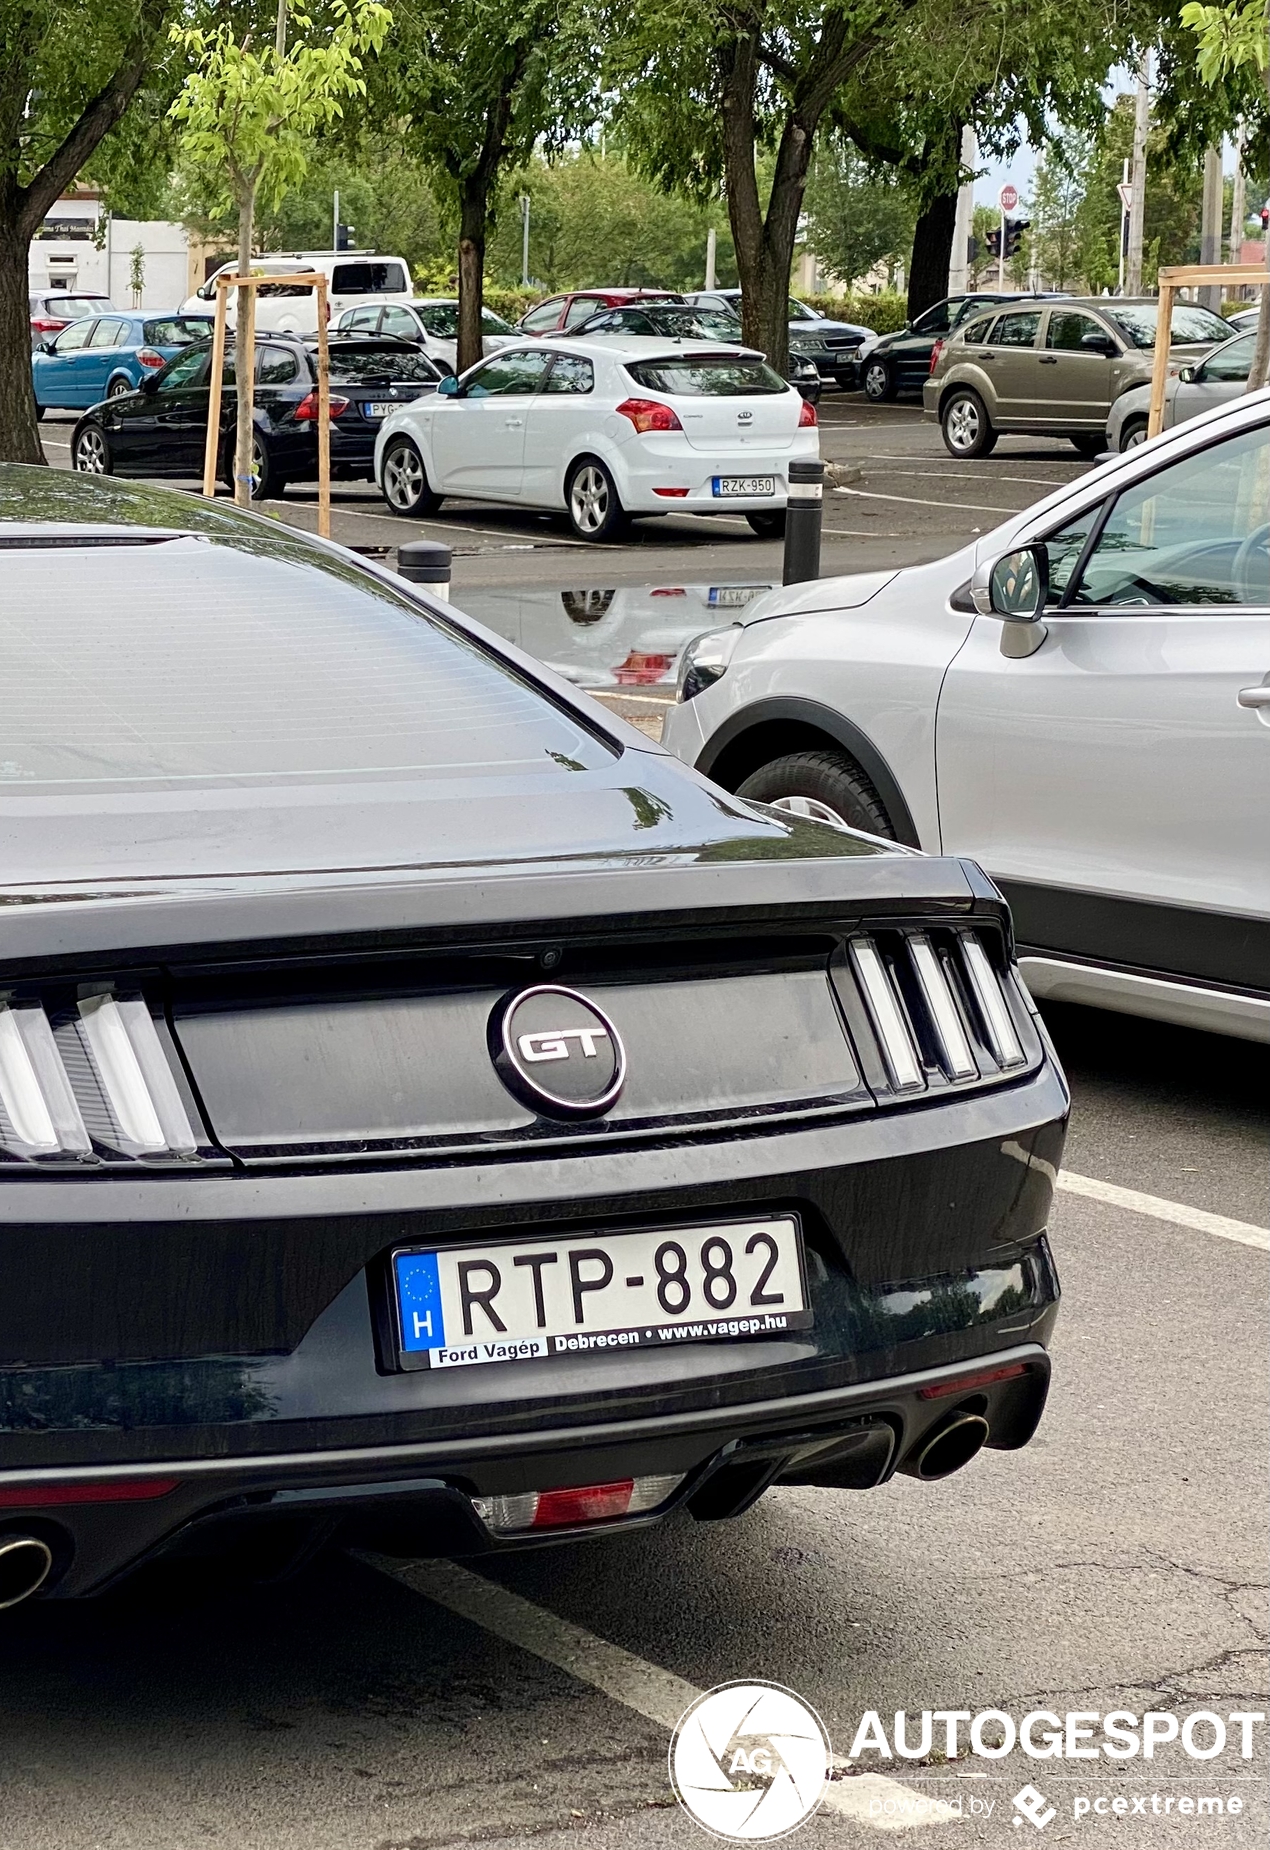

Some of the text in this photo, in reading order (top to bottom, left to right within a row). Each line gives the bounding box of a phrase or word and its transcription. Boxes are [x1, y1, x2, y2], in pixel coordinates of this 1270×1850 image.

[1003, 193, 1016, 203] STOP
[373, 404, 404, 415] PYG-
[722, 479, 771, 492] RZK-950
[517, 1028, 607, 1063] GT
[457, 1231, 785, 1336] RTP-882
[412, 1309, 433, 1339] H
[438, 1314, 787, 1363] Ford Vagép Debrecen www.vagep.hu
